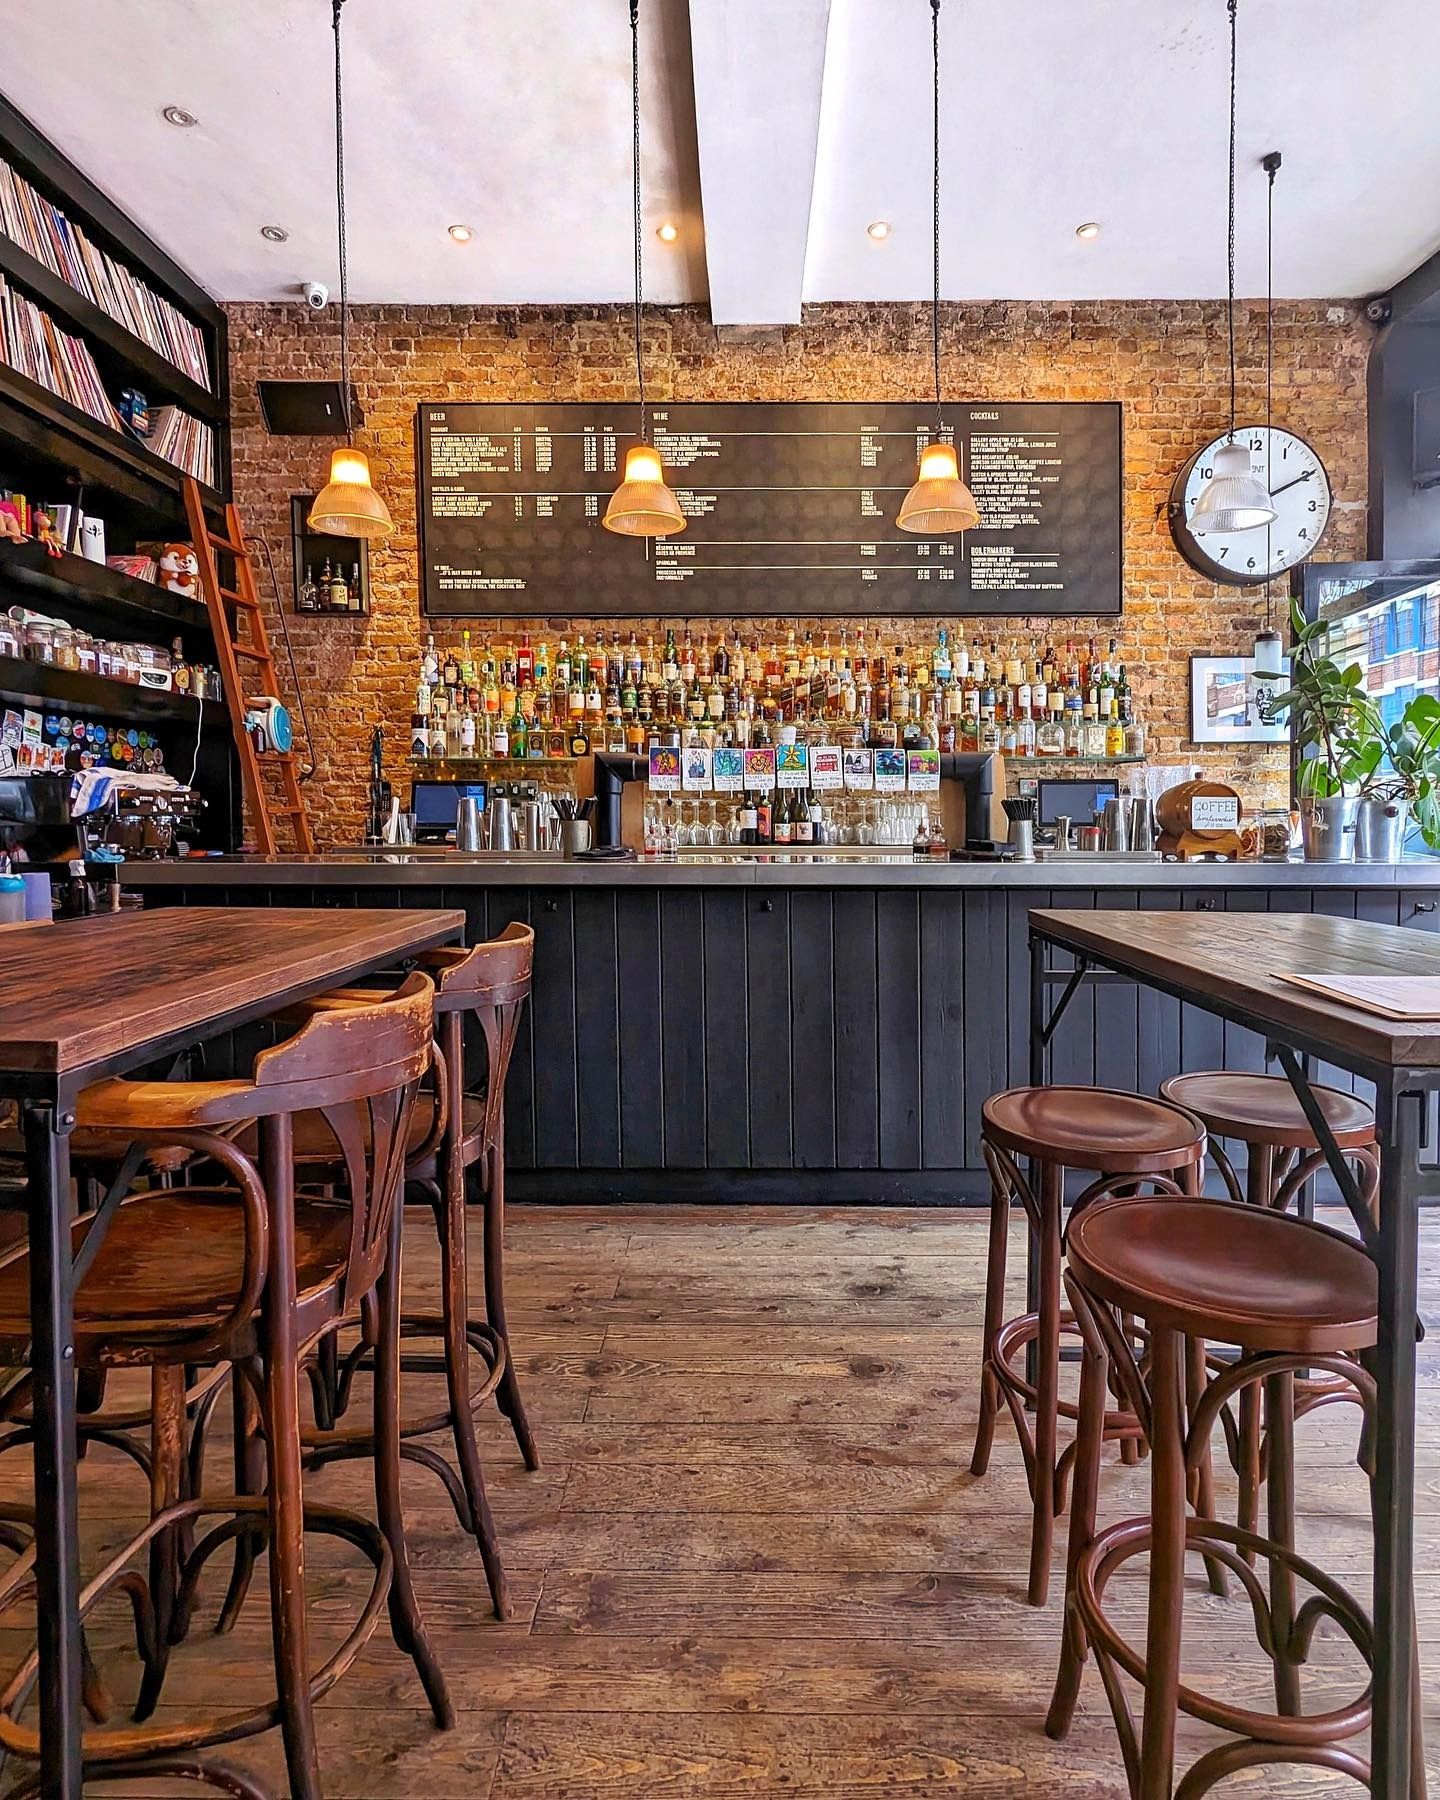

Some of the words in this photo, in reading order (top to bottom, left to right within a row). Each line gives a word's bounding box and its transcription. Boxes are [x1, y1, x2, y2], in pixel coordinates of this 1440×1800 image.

[430, 412, 446, 421] BEER
[653, 412, 668, 421] WINE
[970, 412, 999, 420] COCKTAILS
[1250, 439, 1263, 451] 12
[1283, 448, 1287, 460] 1
[1200, 468, 1213, 479] 10
[1308, 500, 1317, 512] 3
[1298, 528, 1308, 540] 4
[1219, 547, 1229, 559] 7
[1246, 557, 1256, 568] 6
[1194, 800, 1236, 812] COFFEE
